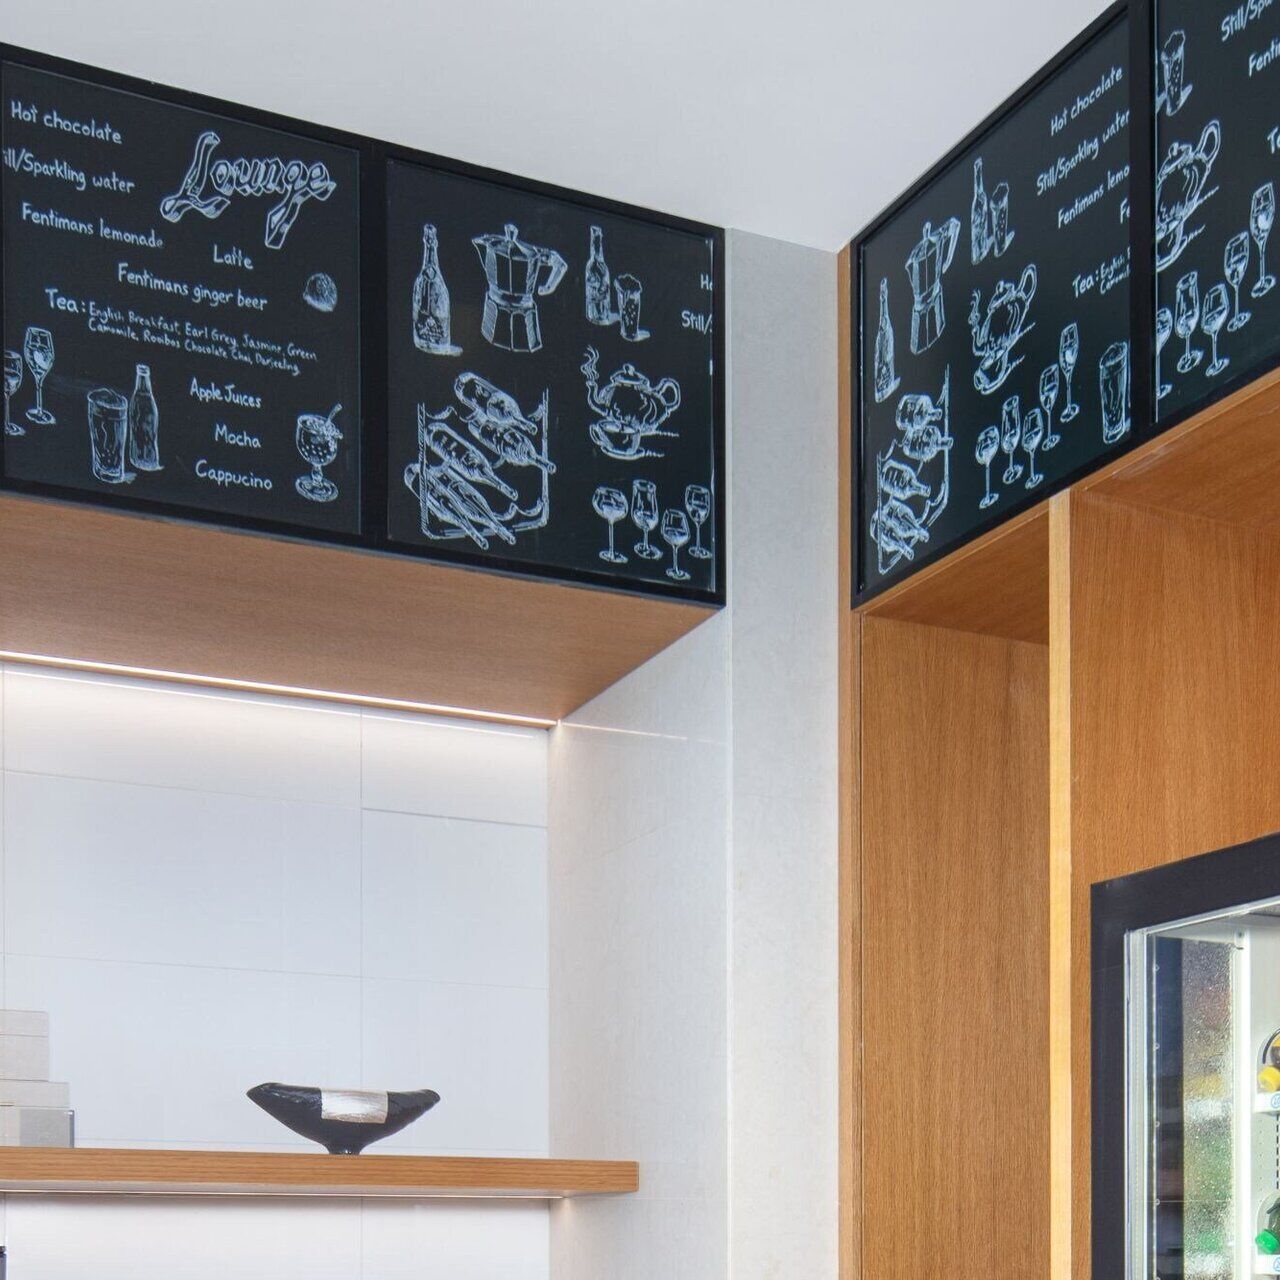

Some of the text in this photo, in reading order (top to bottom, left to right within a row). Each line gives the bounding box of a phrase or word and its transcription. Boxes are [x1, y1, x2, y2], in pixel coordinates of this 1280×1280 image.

[1050, 66, 1122, 136] Hot chocolate
[11, 100, 123, 144] Hot chocolate
[1037, 109, 1130, 196] Still/Sparkling water
[92, 172, 135, 194] water
[160, 131, 338, 250] Lounge
[22, 202, 164, 249] Fentimans lemonade
[1058, 183, 1104, 229] Fentimans
[213, 244, 254, 270] Latte
[118, 262, 268, 311] Fentimans ginger beer
[184, 339, 228, 359] Chocolate
[185, 321, 207, 338] Earl
[287, 342, 317, 360] Green
[190, 377, 262, 409] Apple Juices
[215, 424, 262, 448] Mocha
[195, 460, 273, 491] Cappucino
